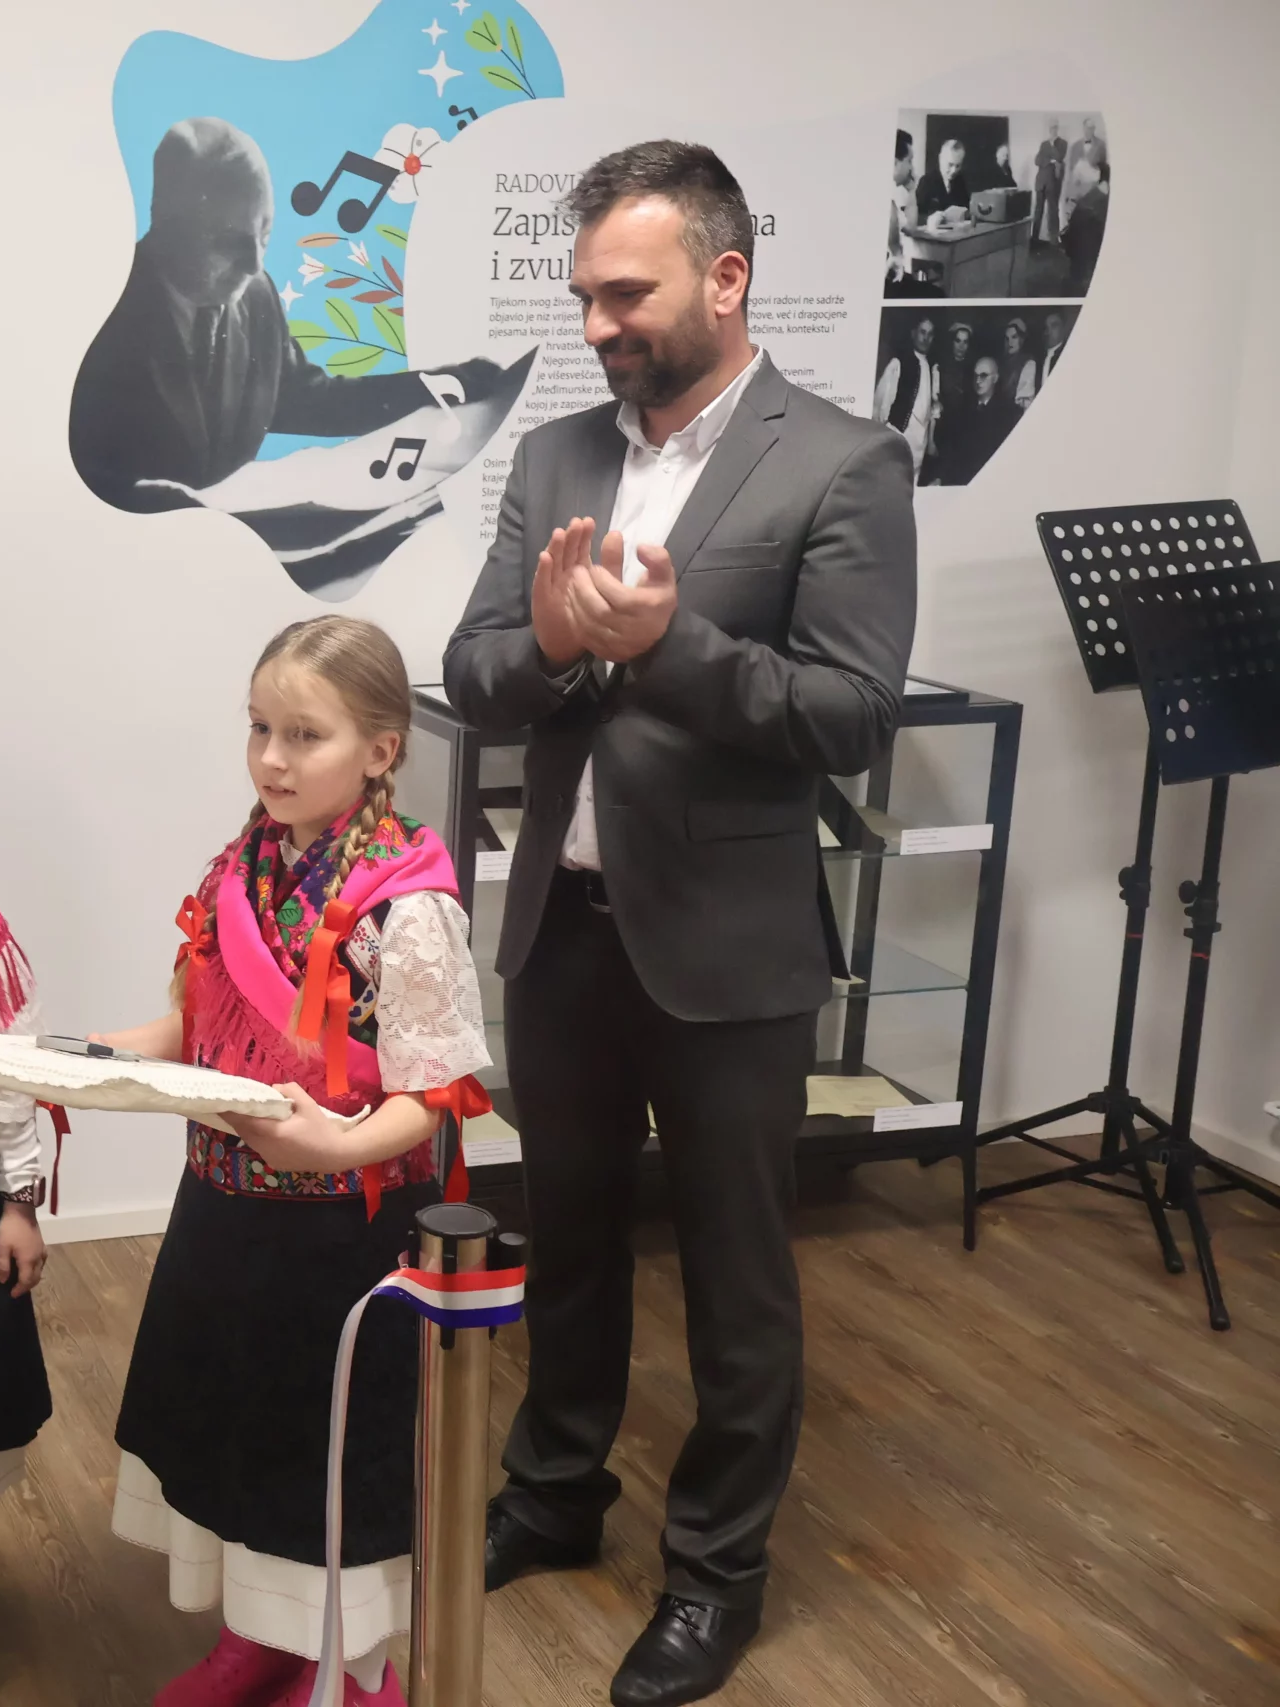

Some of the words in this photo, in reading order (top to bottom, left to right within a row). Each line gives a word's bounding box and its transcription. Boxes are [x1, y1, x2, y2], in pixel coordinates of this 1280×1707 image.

[493, 206, 576, 245] Zapis
[491, 250, 500, 280] i
[490, 297, 527, 308] Tijekom
[529, 298, 551, 308] svog
[553, 296, 581, 307] života
[747, 295, 771, 307] egovi
[773, 294, 801, 304] radovi
[803, 296, 814, 304] ne
[816, 294, 845, 304] sadrže
[489, 312, 524, 323] objavio
[526, 312, 535, 323] je
[536, 312, 550, 321] niz
[776, 309, 792, 319] već
[797, 309, 848, 321] dragocjene
[489, 328, 527, 339] pjesama
[530, 326, 550, 338] koje
[556, 326, 584, 336] danas
[786, 324, 830, 333] kontekstu
[546, 341, 585, 351] hrvatske
[542, 356, 581, 367] Njegovo
[536, 371, 546, 381] je
[525, 400, 548, 411] kojoj
[549, 400, 559, 411] je
[560, 400, 594, 411] zapisao
[518, 416, 545, 426] svoga
[483, 458, 507, 468] Osim
[482, 487, 506, 497] Slavo
[481, 503, 501, 511] rezu
